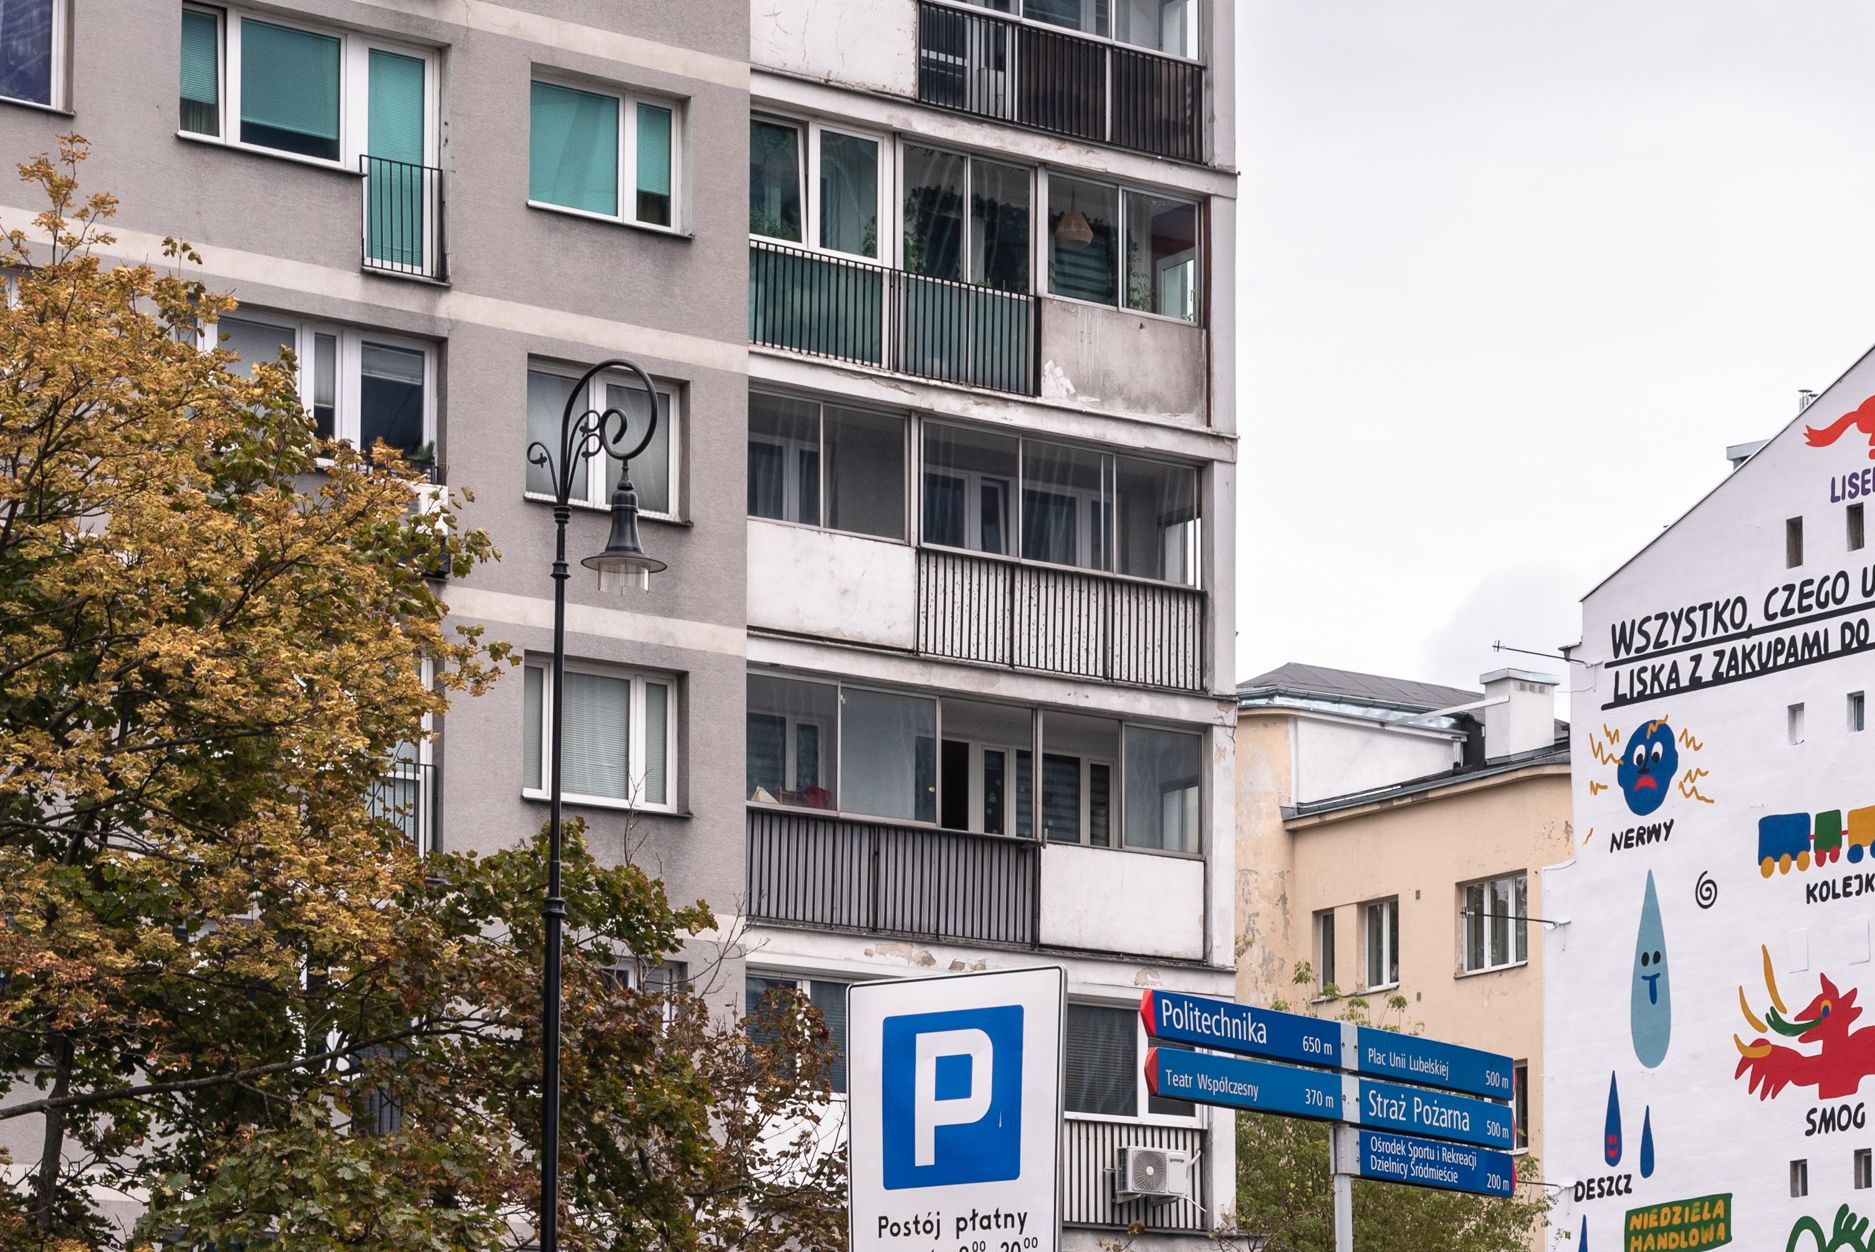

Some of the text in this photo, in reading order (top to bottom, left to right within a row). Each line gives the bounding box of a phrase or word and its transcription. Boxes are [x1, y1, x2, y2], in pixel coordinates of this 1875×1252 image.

[1764, 570, 1849, 621] CZEGO
[1613, 659, 1681, 700] LISKA
[1689, 653, 1703, 685] Z
[1712, 627, 1829, 682] ZAKUPAMI
[1841, 617, 1869, 650] DO
[1610, 818, 1674, 853] NERWY
[1161, 999, 1333, 1056] Politechnika 650 m
[1367, 1047, 1510, 1090] Plac Unii Lubelskiej 500 m
[915, 1028, 994, 1167] P
[1165, 1068, 1334, 1109] Teatr Współczesny 370 m
[1368, 1089, 1510, 1139] Straż Pożarna 500 m
[1804, 1102, 1865, 1137] SMOG
[1370, 1135, 1477, 1168] Ośrodek Sportu i Rekreacji
[1370, 1156, 1510, 1192] Dzielnicy Śródmieście 200 m
[1574, 1174, 1633, 1203] DESZCZ
[878, 1207, 1028, 1241] Postój płatny
[1629, 1199, 1725, 1231] NIEDZIELA
